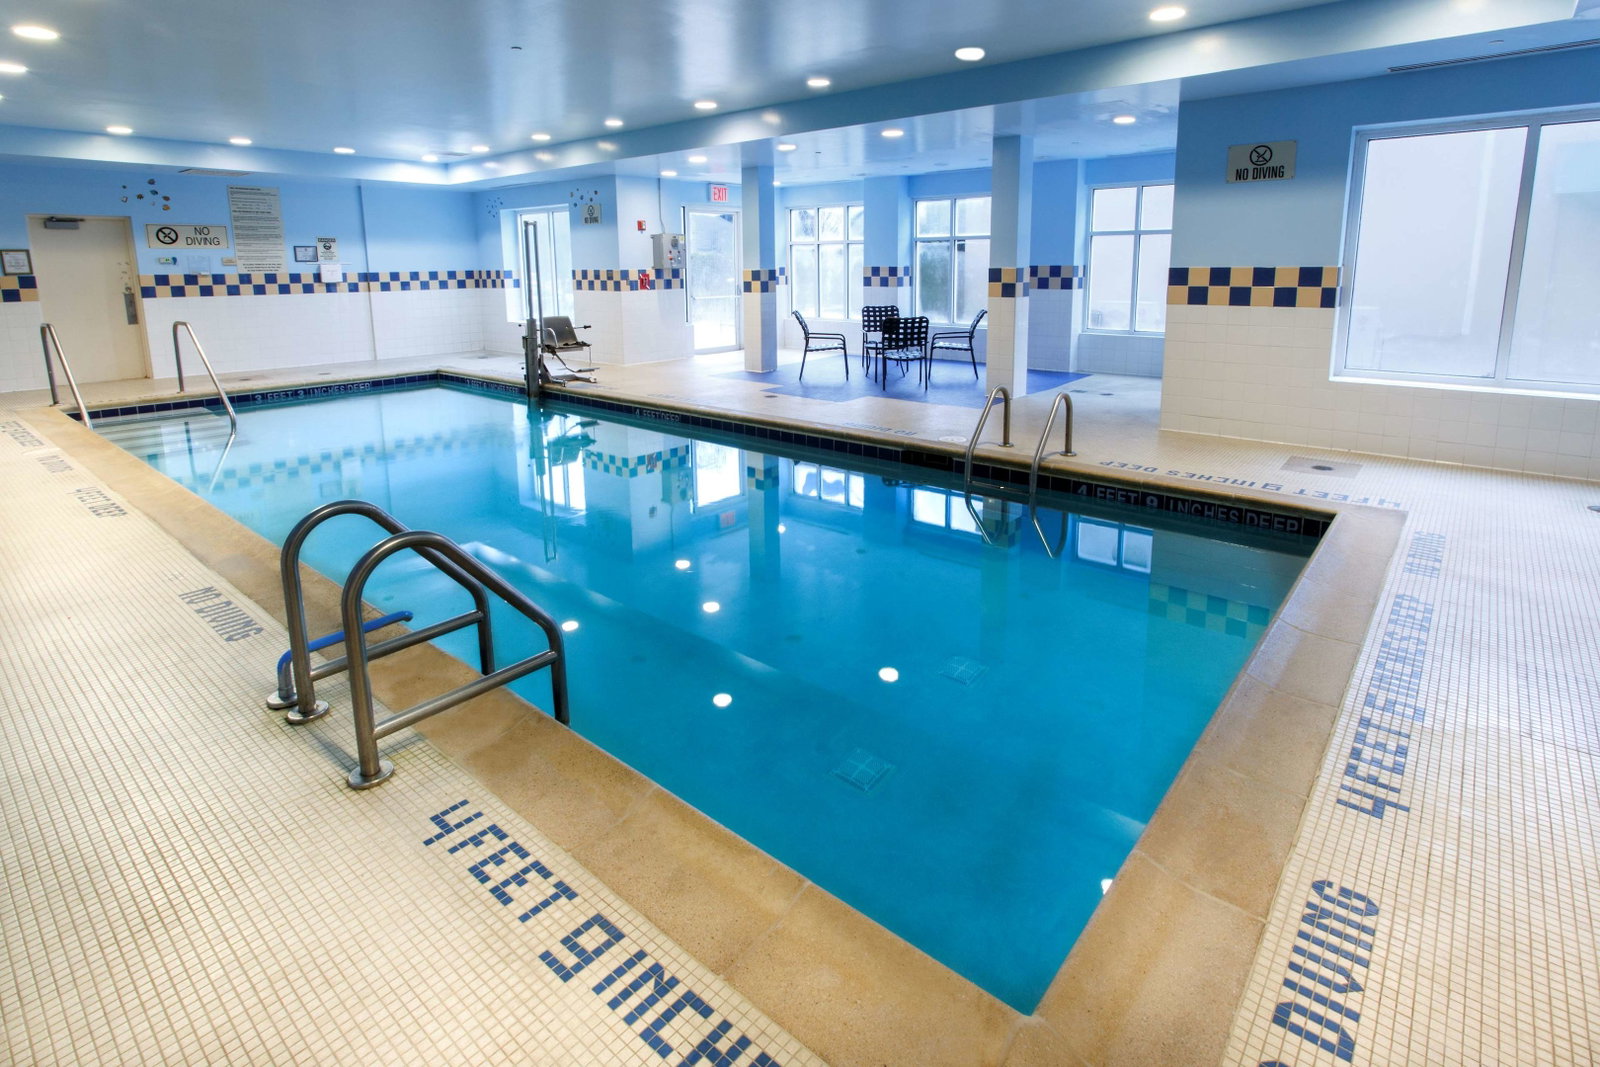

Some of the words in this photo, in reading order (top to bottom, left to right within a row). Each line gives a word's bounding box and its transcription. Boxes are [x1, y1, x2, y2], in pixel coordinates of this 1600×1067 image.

[1235, 167, 1249, 181] NO
[1252, 165, 1285, 180] DIVING
[713, 186, 728, 201] EXIT
[185, 236, 221, 246] DIVING
[194, 226, 210, 236] NO
[254, 394, 263, 405] 3
[267, 391, 293, 403] FEET
[309, 386, 345, 398] INCHES
[1099, 460, 1158, 473] DEEP
[1165, 470, 1256, 487] INCHES
[1077, 484, 1088, 498] 4
[1096, 487, 1138, 504] FEET
[1147, 496, 1158, 508] 9
[1169, 498, 1241, 524] INCHES
[1246, 513, 1300, 533] DEEP
[1292, 487, 1370, 505] FEET
[1378, 497, 1401, 508] 4
[178, 586, 222, 604] NO
[1387, 593, 1434, 633] DEEP
[195, 600, 263, 642] DIVING
[1370, 631, 1427, 699] INCHES
[1345, 716, 1410, 793] FEET
[1336, 784, 1410, 820] 4
[423, 799, 484, 847] 4
[447, 823, 579, 924] FEET
[538, 913, 627, 984] 9
[1272, 879, 1380, 1063] DIVING
[591, 948, 784, 1067] INCH
